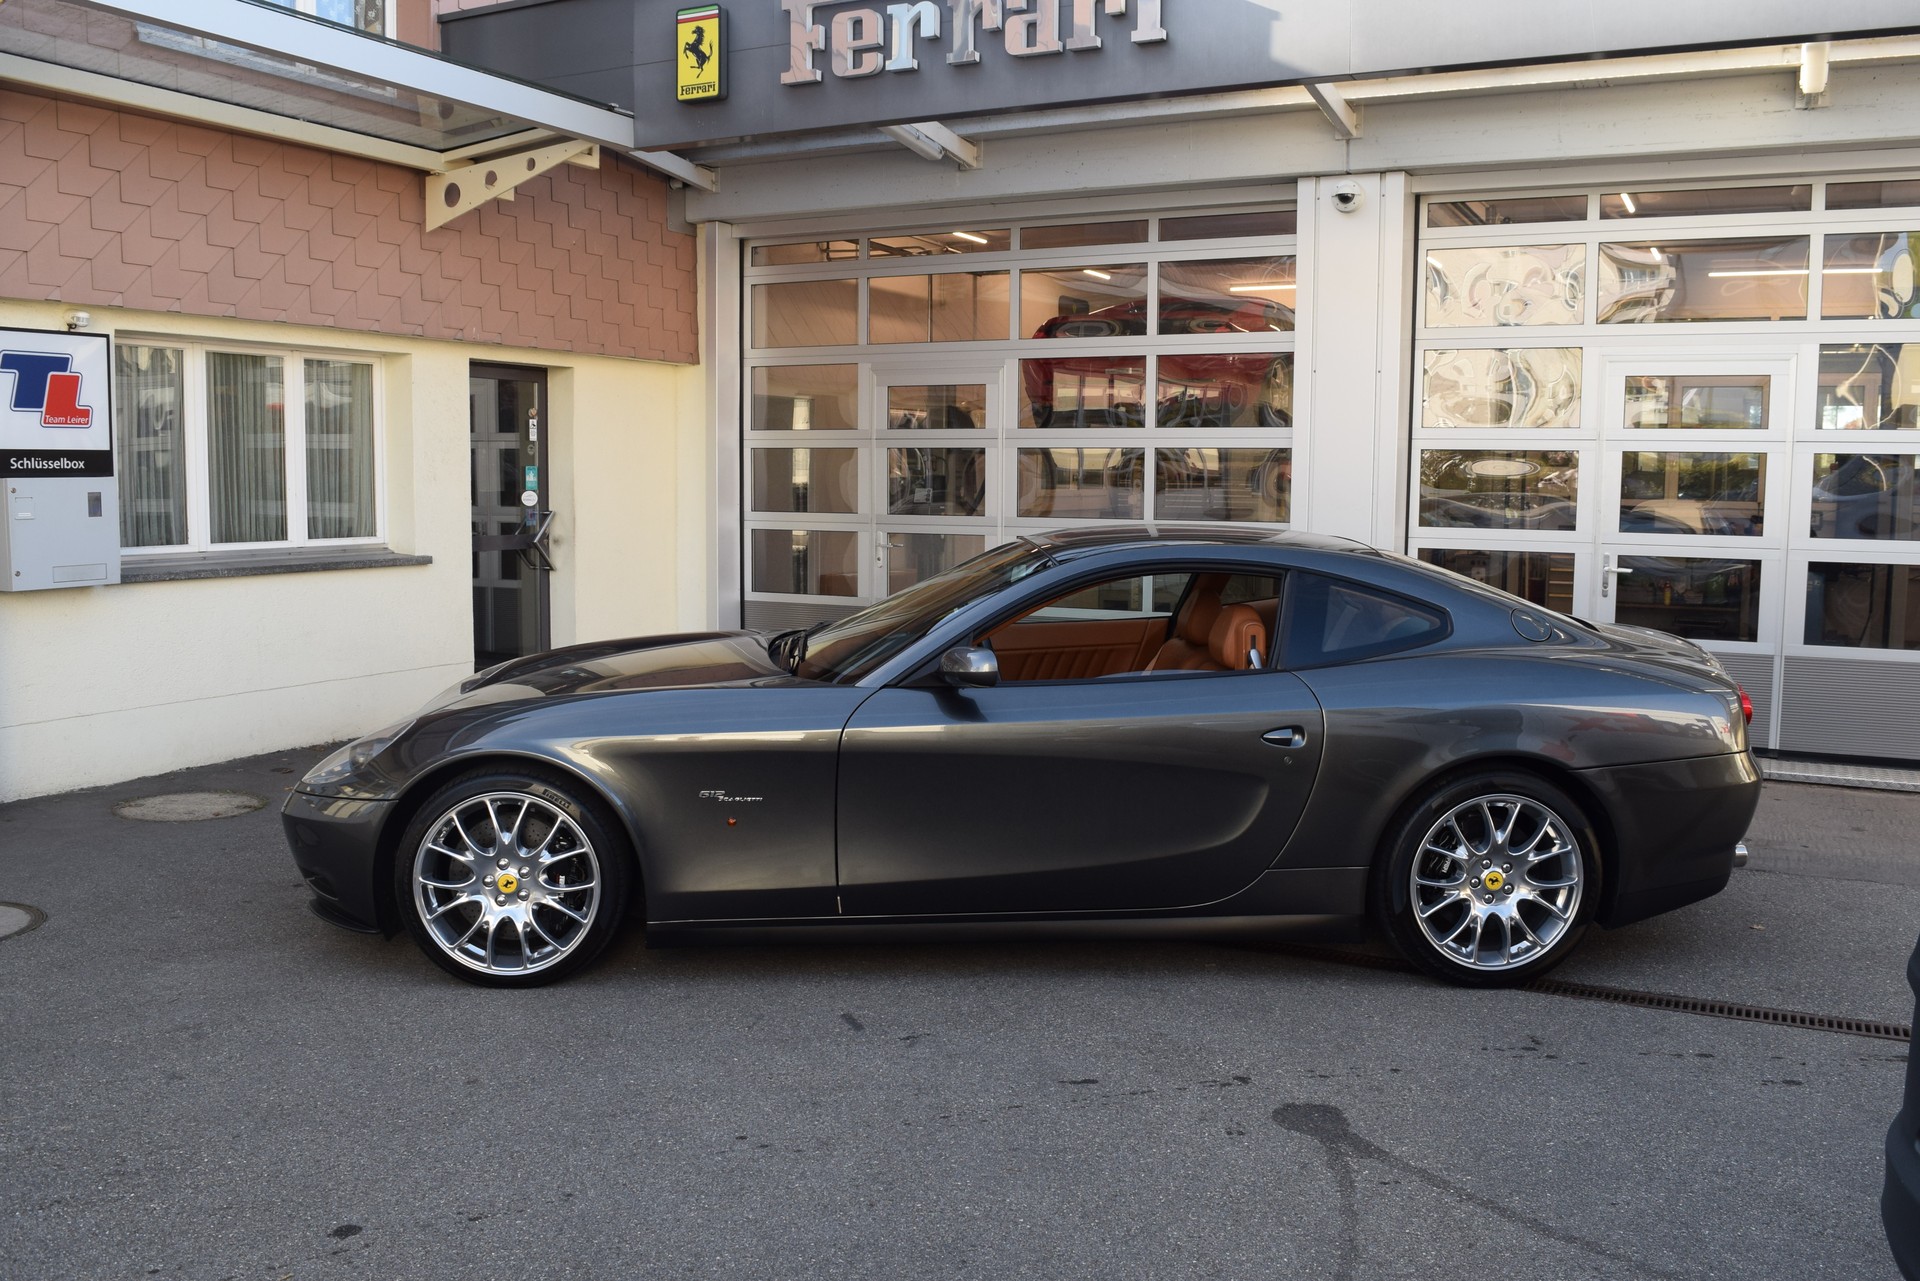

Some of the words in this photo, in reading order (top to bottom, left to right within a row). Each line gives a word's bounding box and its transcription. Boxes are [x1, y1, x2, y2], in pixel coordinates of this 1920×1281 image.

[680, 81, 716, 96] Ferrari
[45, 415, 66, 423] Team
[67, 416, 89, 424] Leirer
[10, 457, 85, 469] Schlüsselbox
